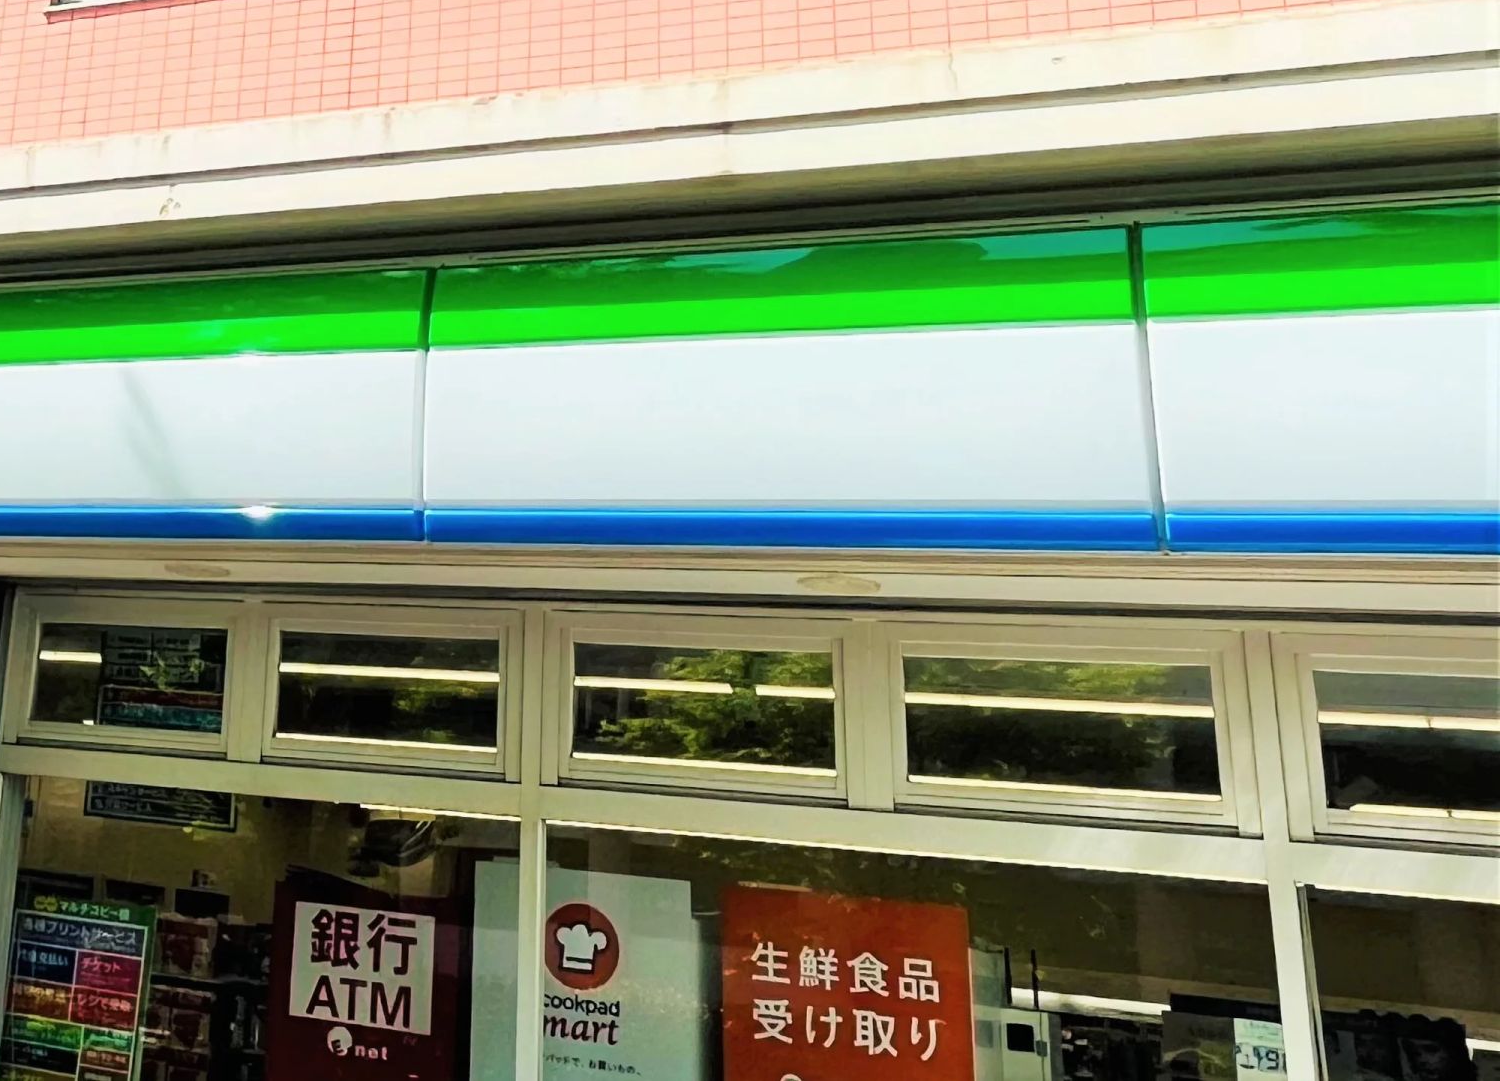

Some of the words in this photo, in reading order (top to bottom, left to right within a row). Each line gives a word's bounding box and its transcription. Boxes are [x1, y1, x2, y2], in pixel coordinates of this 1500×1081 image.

[310, 908, 419, 977] 銀行
[750, 941, 941, 1003] 生鮮食品
[306, 975, 411, 1028] ATM
[543, 1015, 619, 1046] mart
[753, 997, 947, 1062] 受け取り
